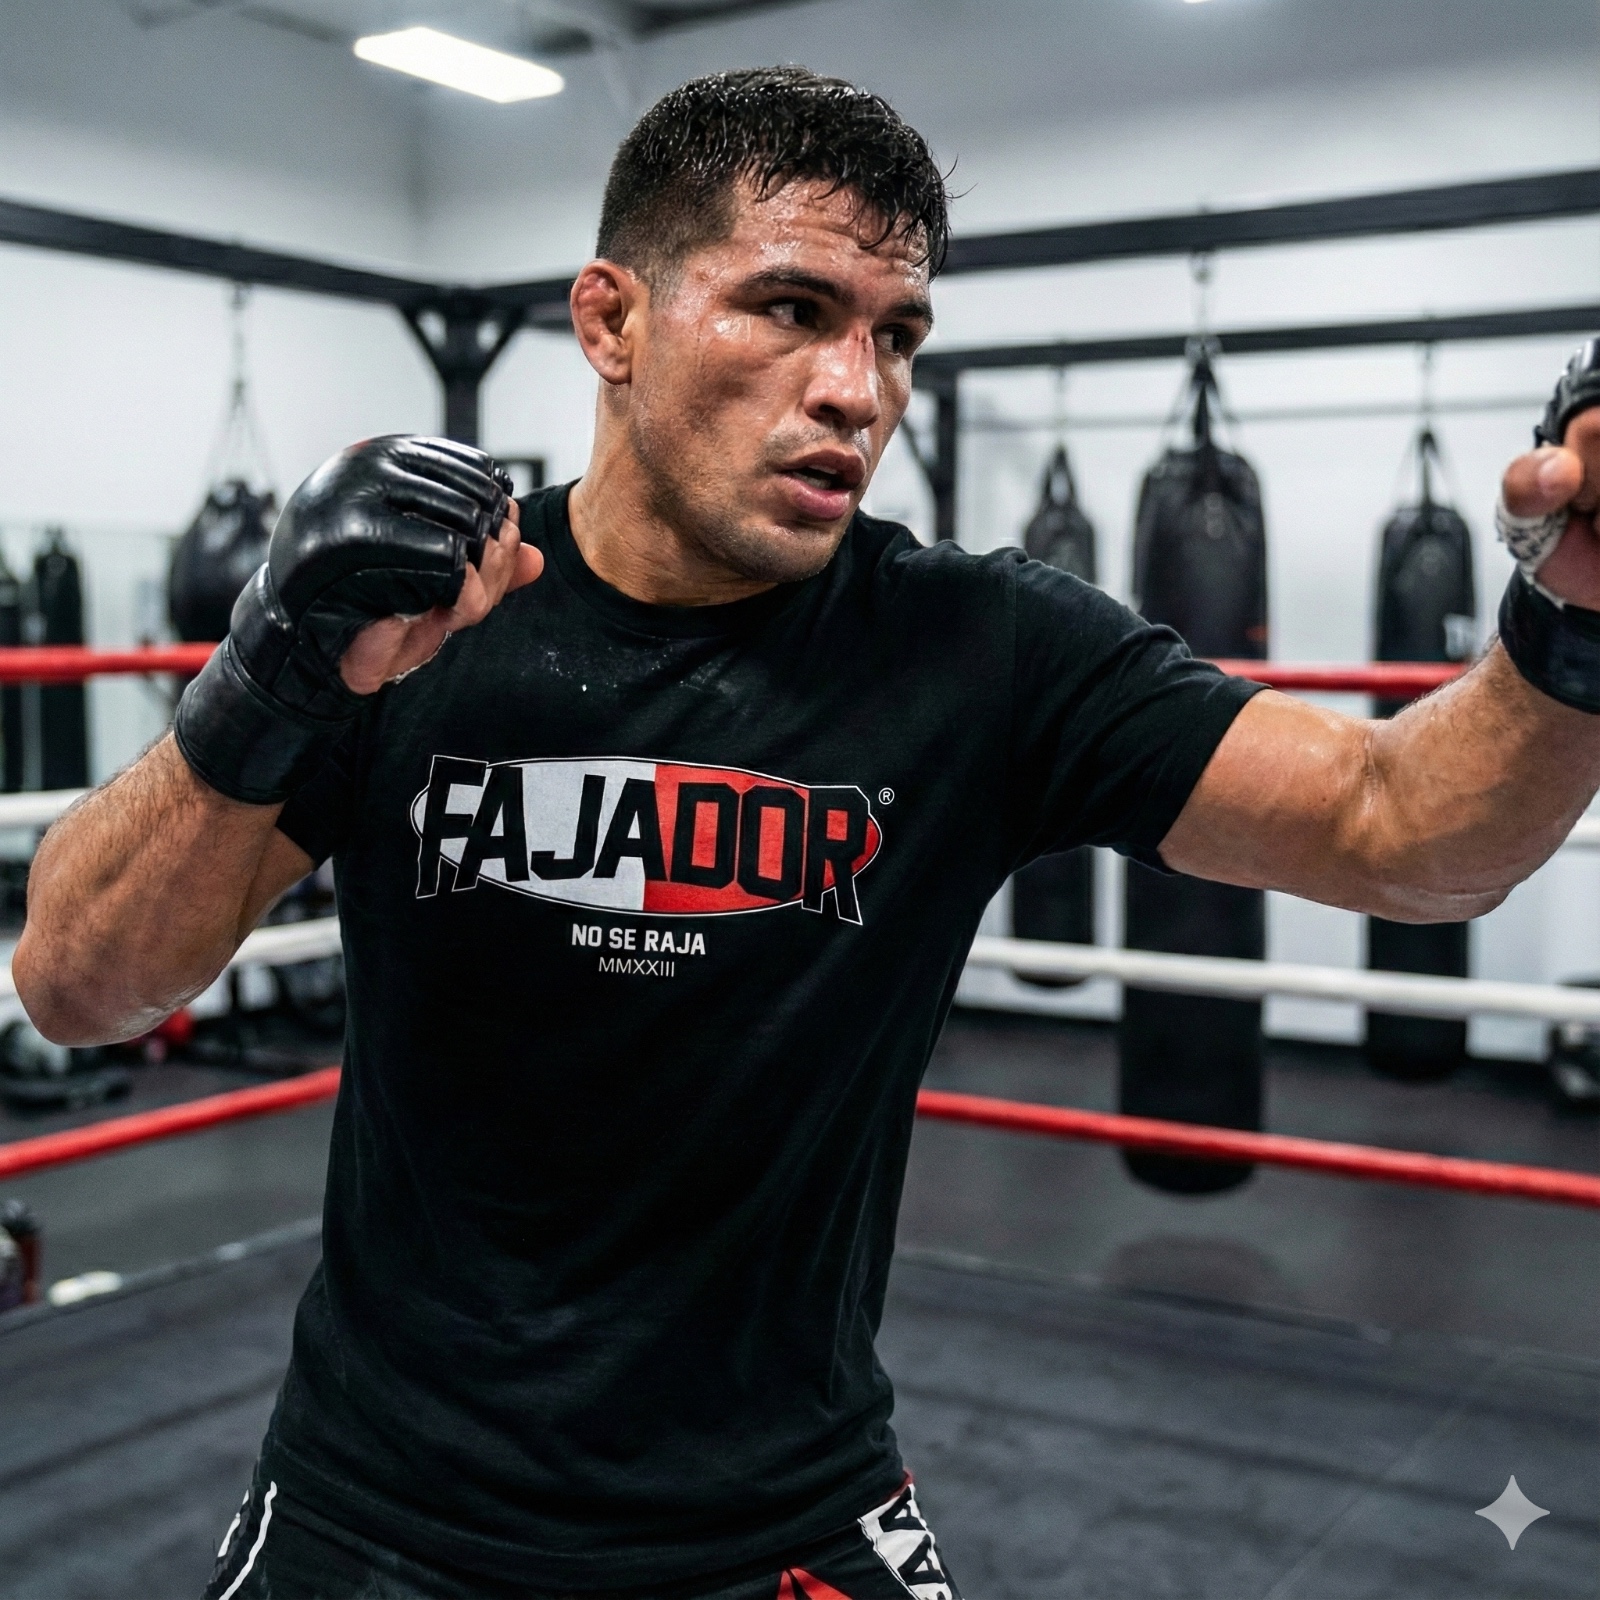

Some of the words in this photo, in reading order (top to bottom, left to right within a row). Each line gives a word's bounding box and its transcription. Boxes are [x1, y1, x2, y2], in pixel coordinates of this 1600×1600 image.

[415, 755, 870, 925] FAJADOR
[571, 923, 603, 947] NO
[608, 927, 637, 950] SE
[644, 930, 706, 955] RAJA
[598, 957, 675, 977] MMXXIII
